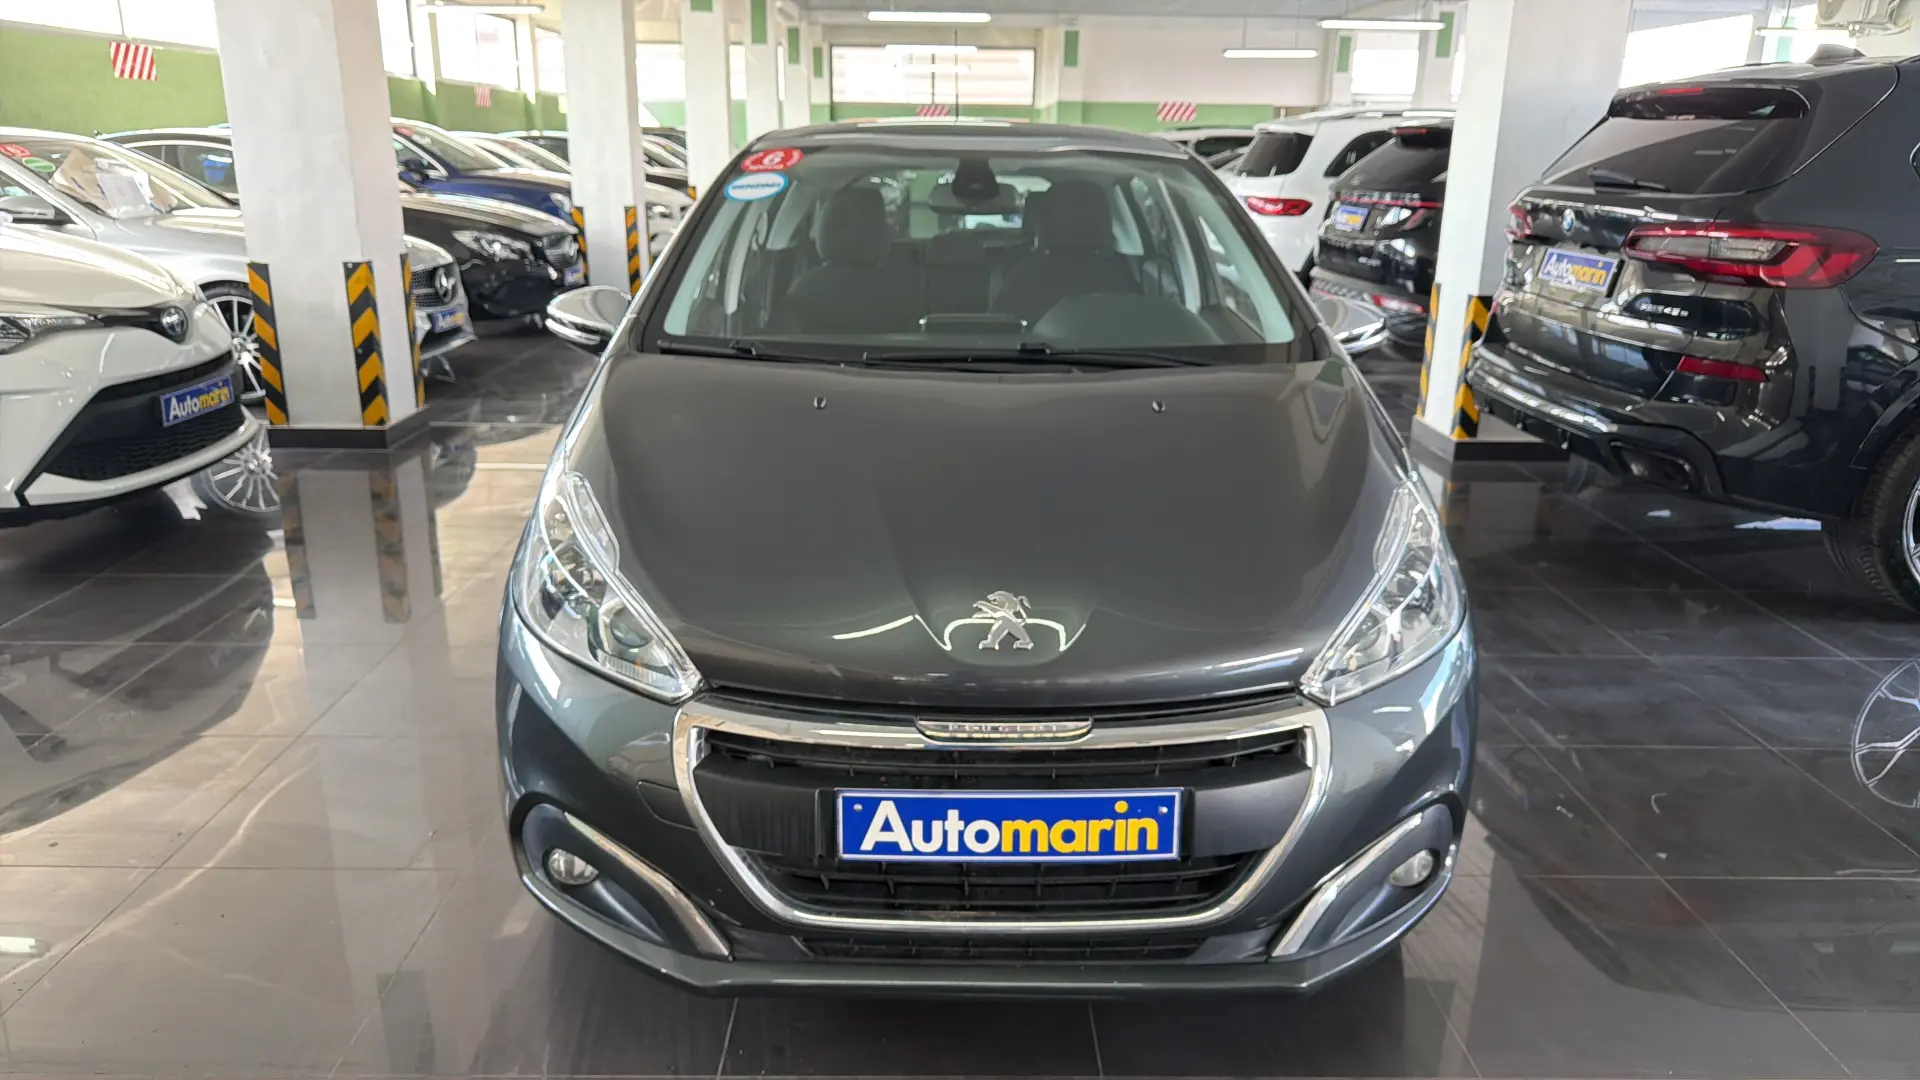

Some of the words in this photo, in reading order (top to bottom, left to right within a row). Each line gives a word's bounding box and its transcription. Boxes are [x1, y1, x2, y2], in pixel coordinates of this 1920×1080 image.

[762, 151, 785, 166] 6
[1543, 252, 1608, 285] Automarin
[169, 381, 231, 421] Automarin
[860, 800, 1159, 853] Automarin
